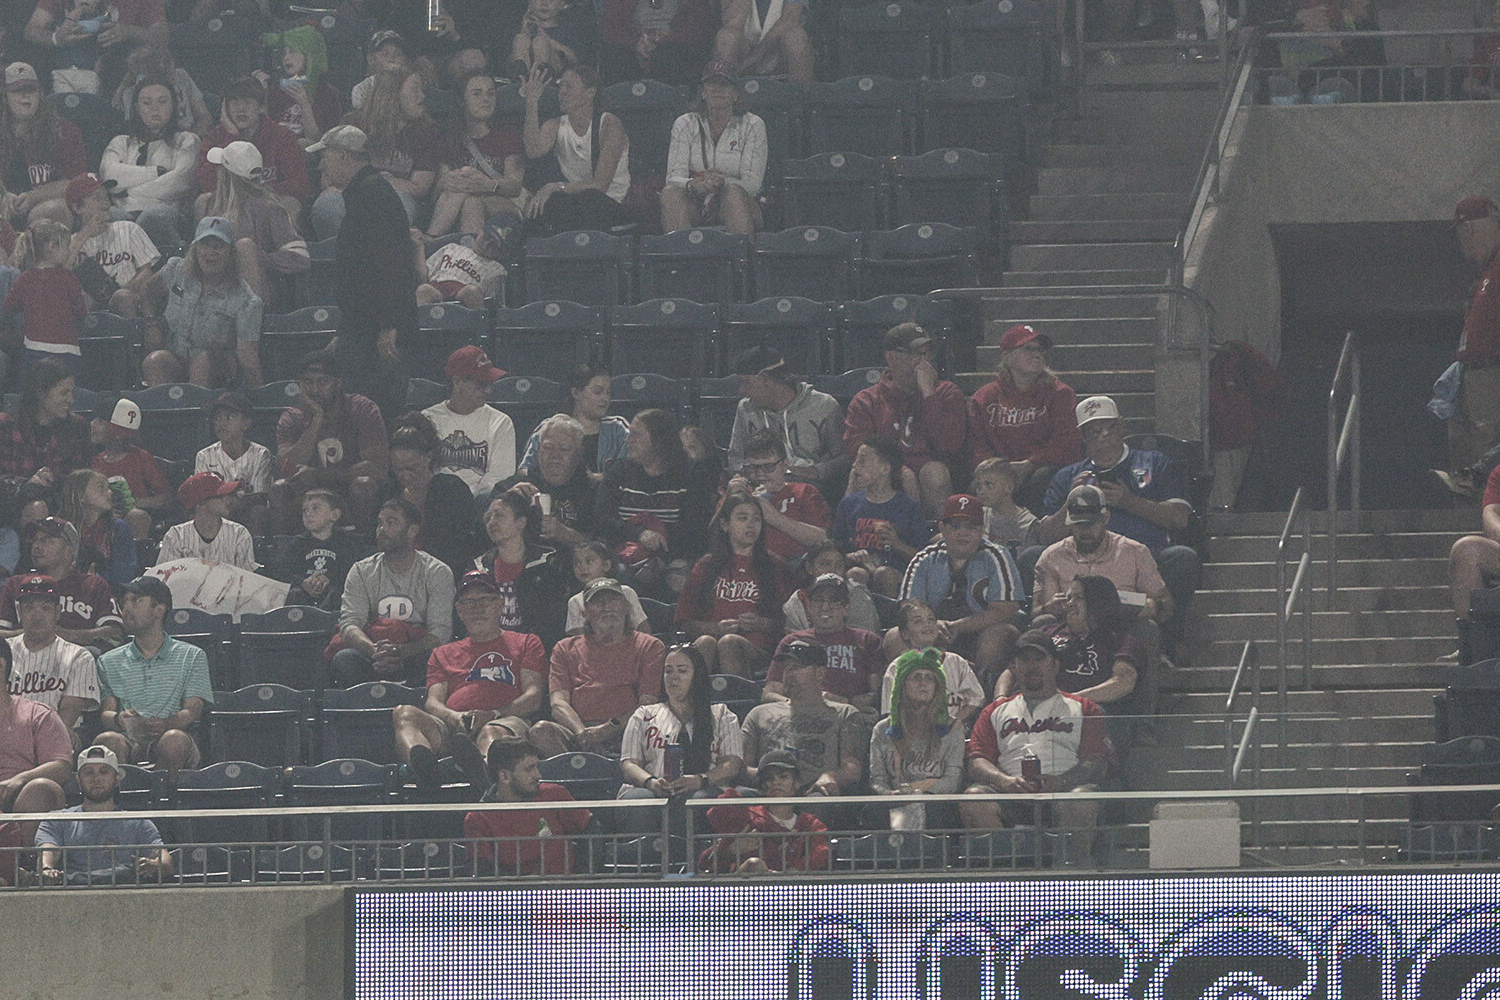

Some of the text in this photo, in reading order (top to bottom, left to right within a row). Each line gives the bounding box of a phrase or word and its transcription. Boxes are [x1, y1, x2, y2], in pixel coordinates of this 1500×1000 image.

[440, 254, 483, 283] Phillies
[128, 410, 137, 424] P
[317, 437, 344, 468] P
[959, 496, 969, 511] P
